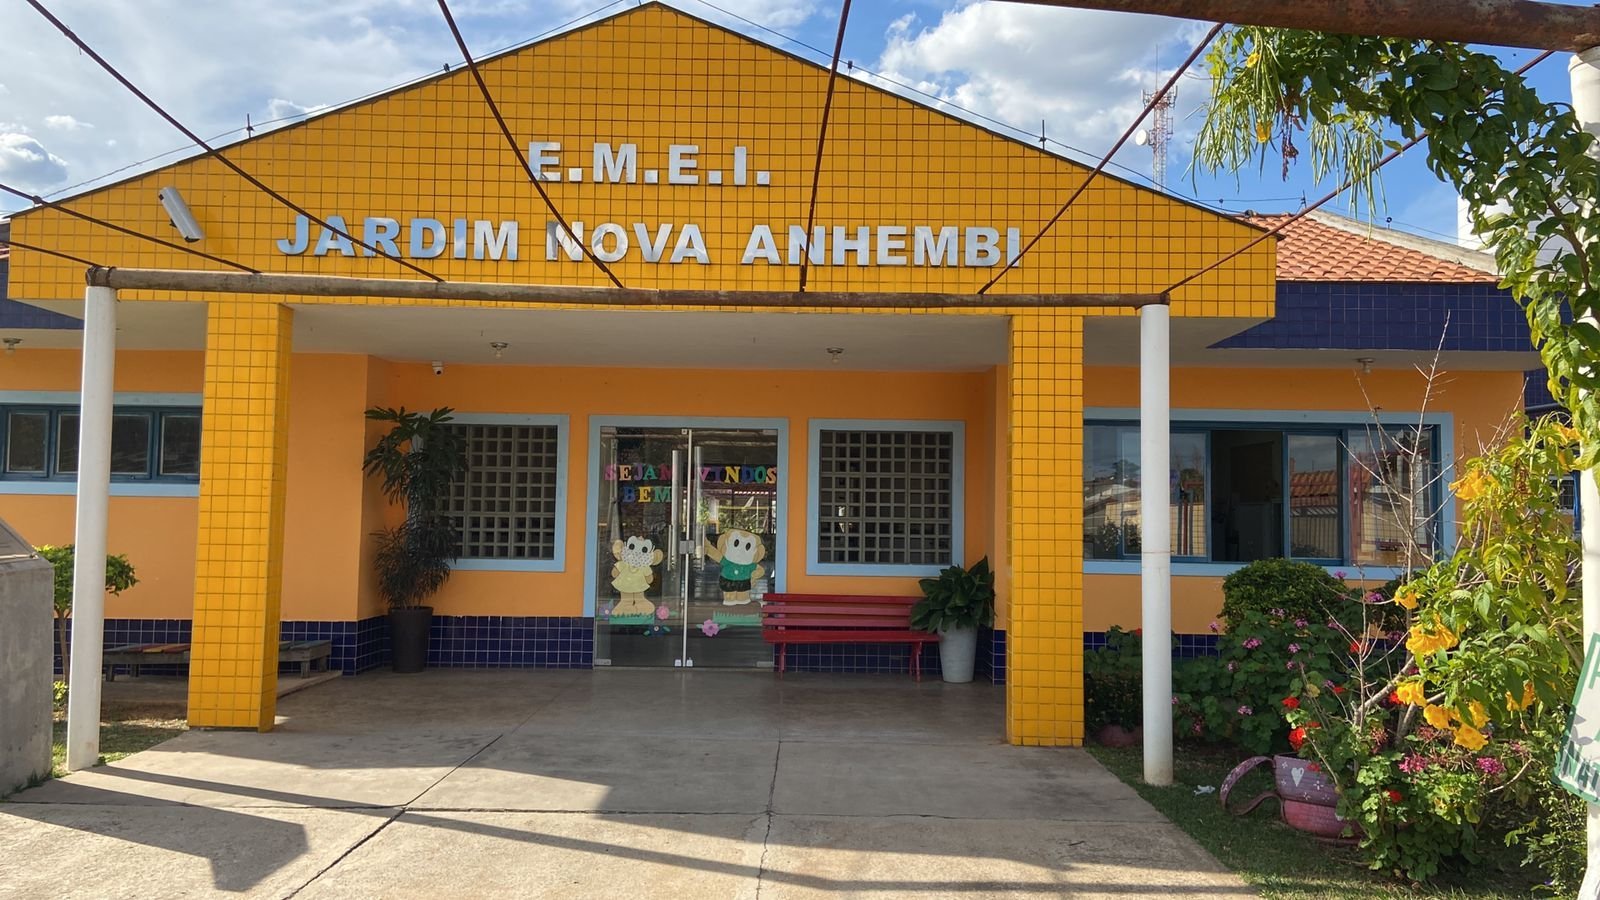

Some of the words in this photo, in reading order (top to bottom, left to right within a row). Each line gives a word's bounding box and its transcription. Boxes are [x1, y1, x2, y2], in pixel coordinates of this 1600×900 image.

[528, 141, 770, 186] E.M.E.I.
[276, 214, 518, 261] JARDIM
[546, 221, 711, 264] NOVA
[741, 224, 1020, 267] ANHEMBI
[699, 465, 777, 484] VINDOS
[622, 486, 673, 503] BEM
